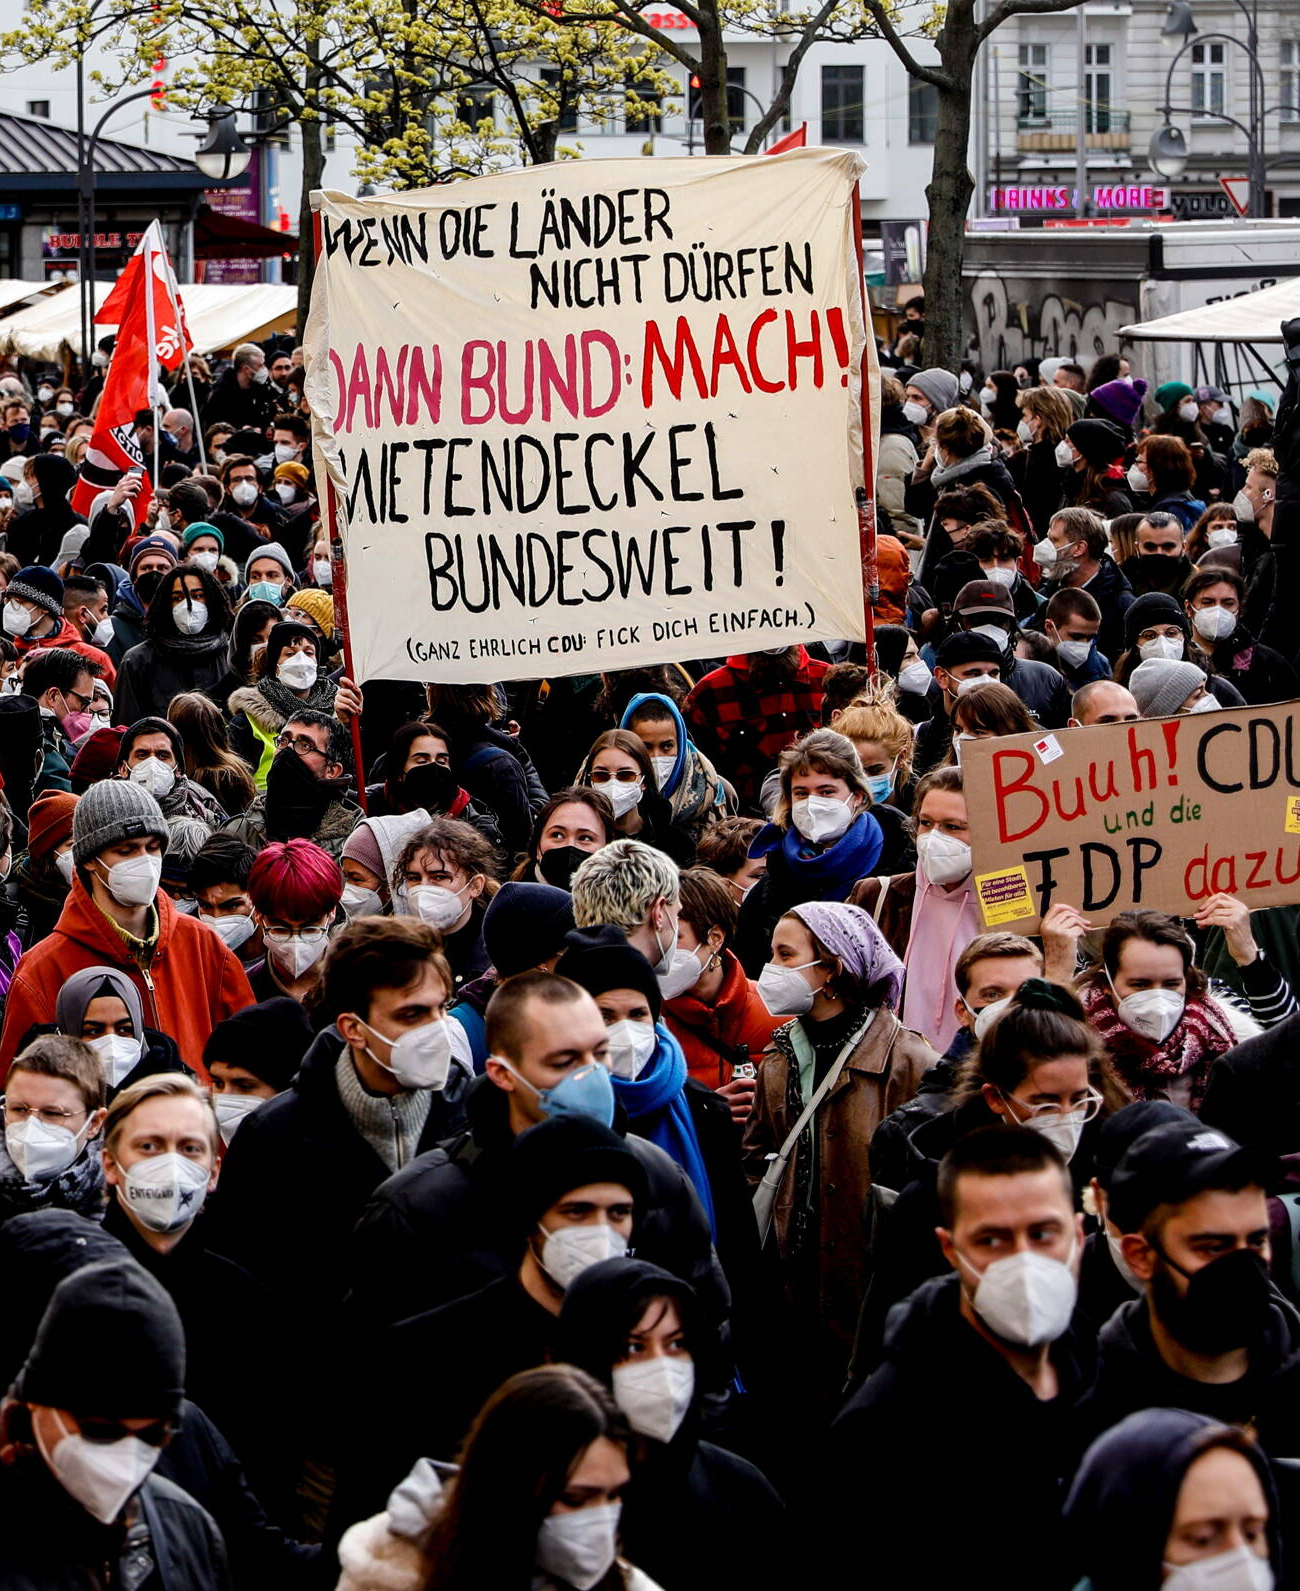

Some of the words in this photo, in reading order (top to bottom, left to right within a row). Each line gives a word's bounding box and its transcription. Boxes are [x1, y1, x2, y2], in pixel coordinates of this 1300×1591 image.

[324, 210, 429, 267] WENN
[439, 203, 497, 260] DIE
[509, 187, 673, 260] LÄNDER
[990, 186, 1069, 209] DRINKS
[530, 254, 651, 310] NICHT
[663, 242, 814, 303] DÜRFEN
[642, 307, 849, 408] MACH!
[425, 520, 785, 613] BUNDESWEIT!
[406, 637, 460, 664] (GANZ
[469, 638, 541, 659] EHRLICH
[547, 632, 588, 654] CDU:
[597, 625, 641, 649] FICK
[652, 617, 699, 642] DICH
[709, 601, 816, 634] EINFACH.)
[992, 720, 1180, 844] Buuh!
[1103, 801, 1154, 834] und
[1170, 795, 1202, 824] die
[981, 889, 991, 897] mit
[992, 878, 1005, 886] eine
[1023, 837, 1163, 918] FDP
